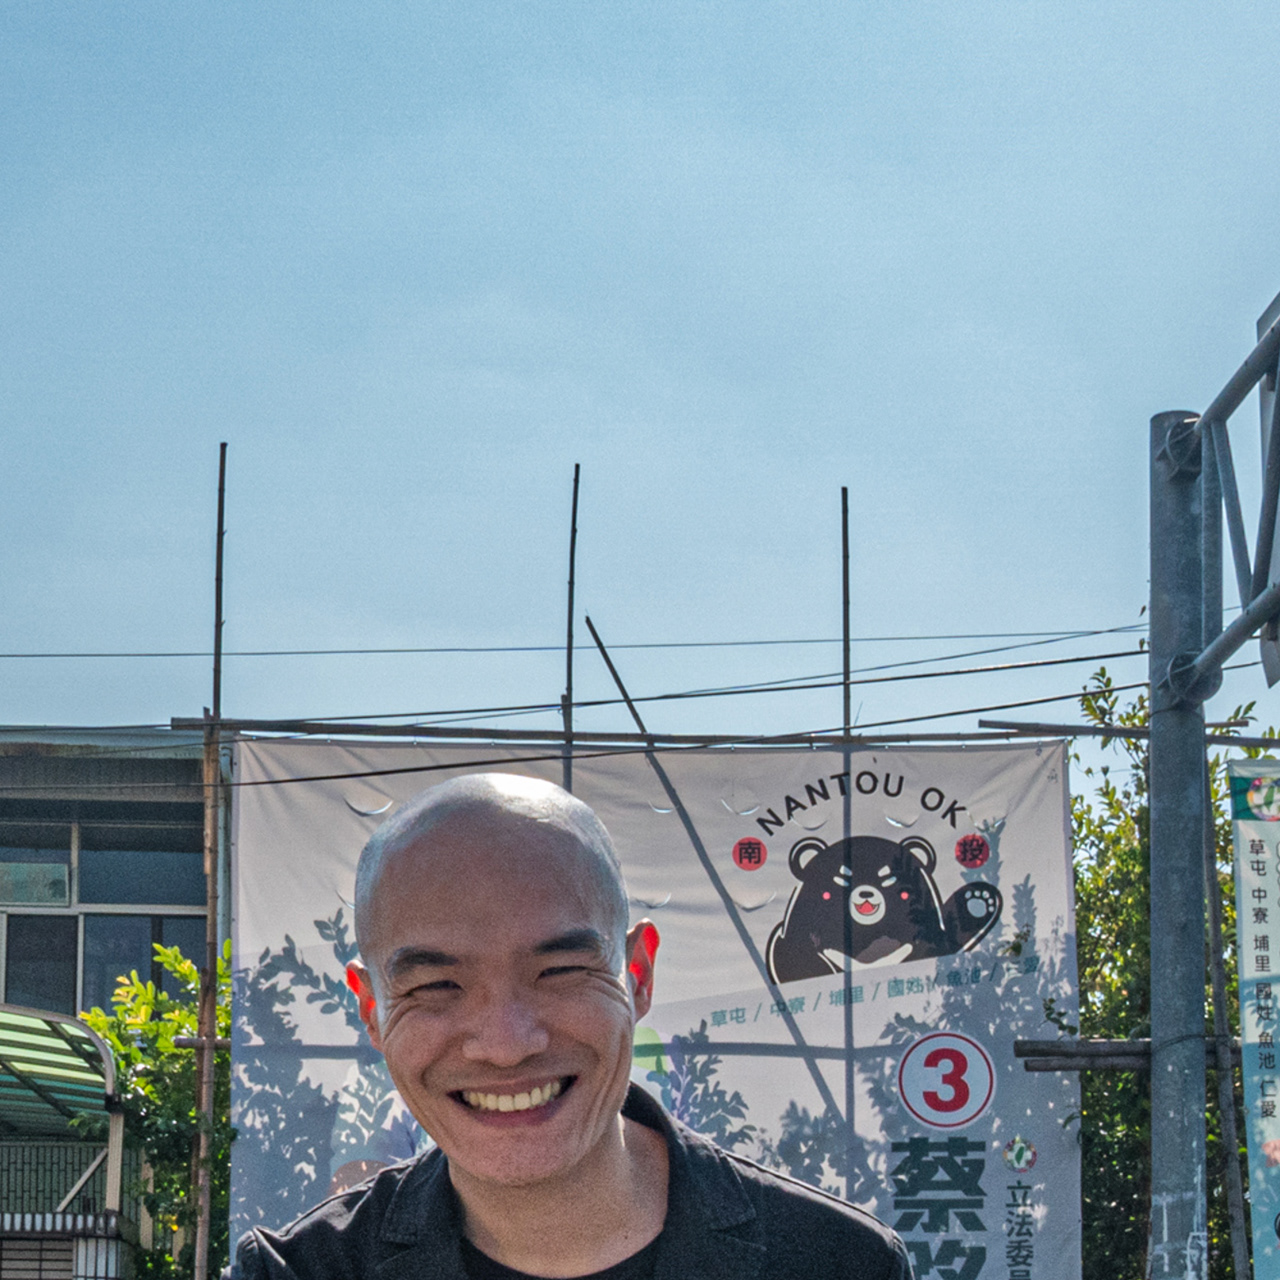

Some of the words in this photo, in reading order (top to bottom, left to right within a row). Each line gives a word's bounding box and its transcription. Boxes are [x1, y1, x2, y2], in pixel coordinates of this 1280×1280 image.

[756, 770, 905, 837] NANTOU
[920, 786, 968, 830] OK
[737, 841, 762, 866] 南
[958, 839, 985, 865] 投
[1249, 838, 1267, 877] 草屯
[1251, 886, 1269, 925] 中寮
[1253, 934, 1271, 974] 埔里
[710, 1008, 747, 1029] 草屯
[769, 995, 807, 1018] 中寮
[829, 985, 865, 1009] 埔里
[1255, 982, 1274, 1023] 國姓
[1257, 1030, 1276, 1070] 魚池
[923, 1047, 971, 1113] 3
[1259, 1079, 1278, 1120] 仁愛
